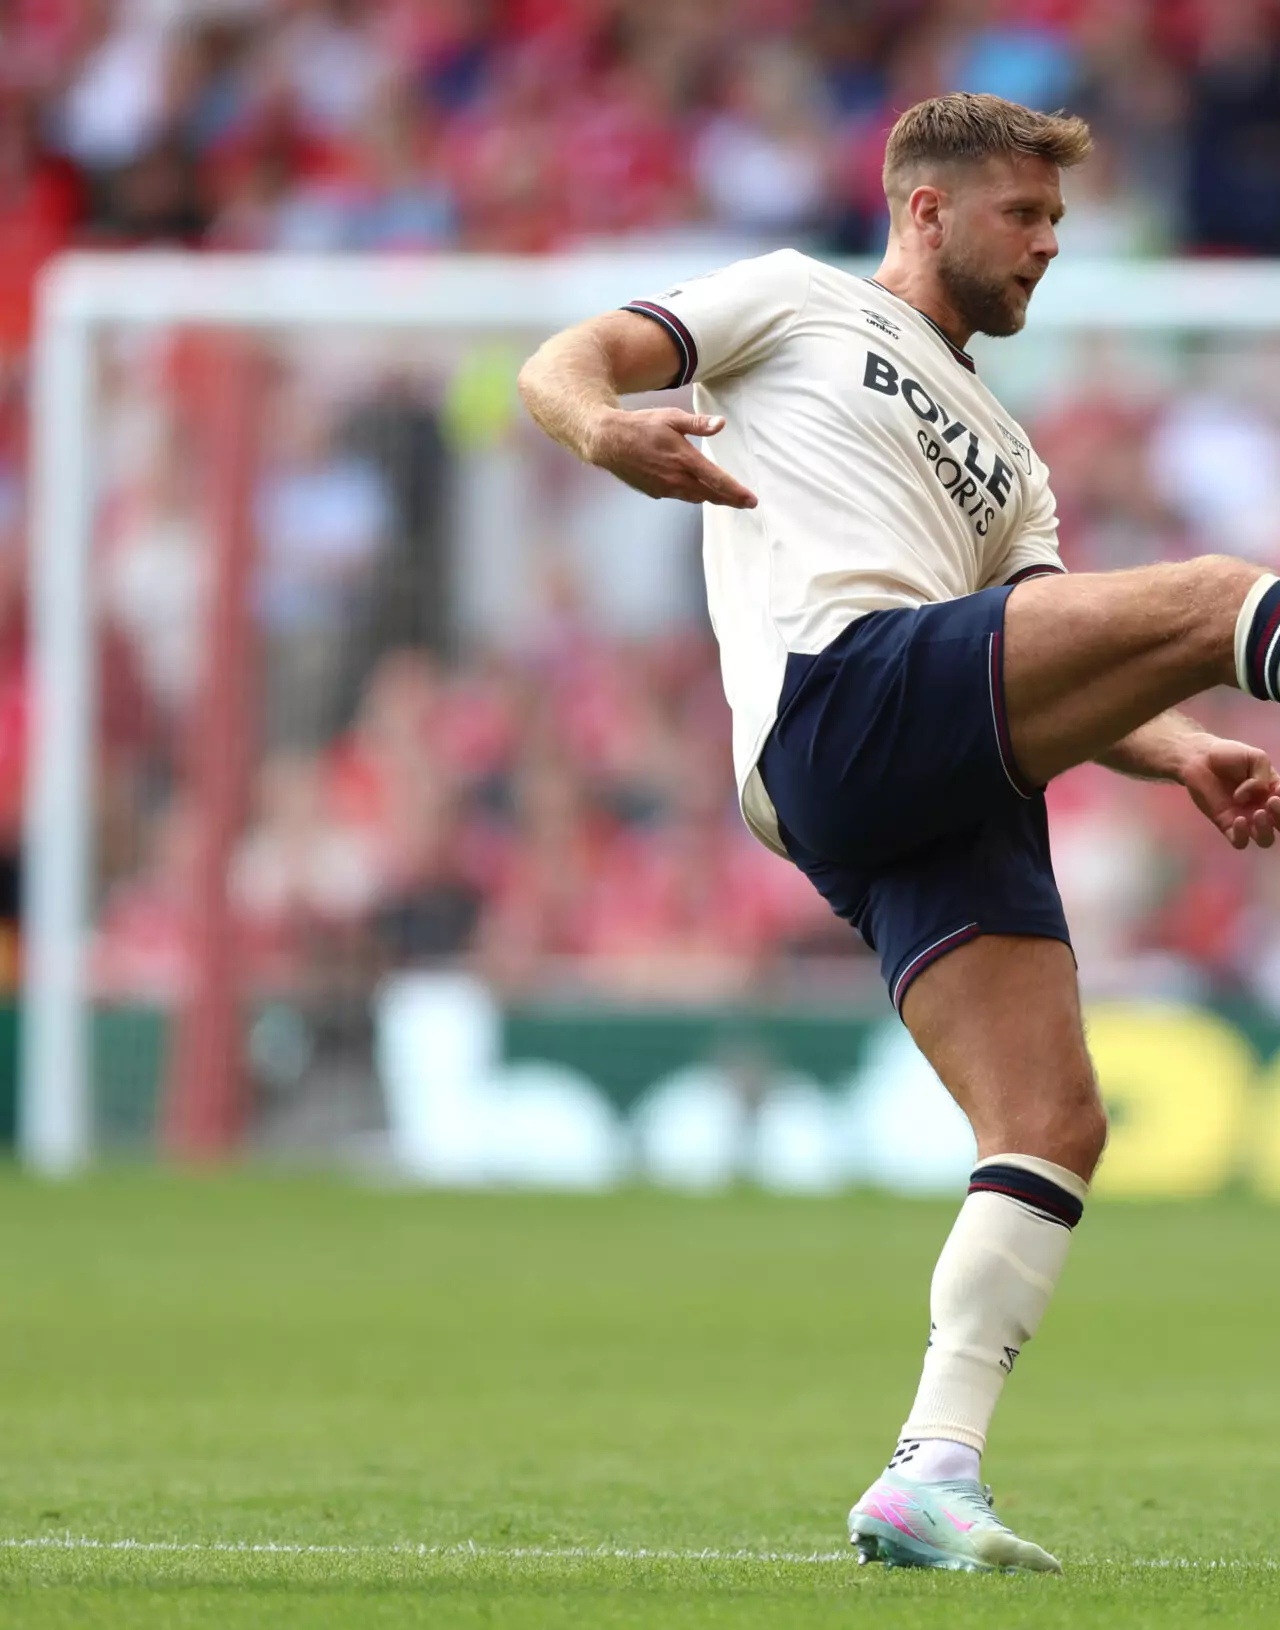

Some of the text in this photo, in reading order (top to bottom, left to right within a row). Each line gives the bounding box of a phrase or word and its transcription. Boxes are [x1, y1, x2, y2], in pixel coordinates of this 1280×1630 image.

[866, 318, 899, 340] umbro
[863, 351, 1013, 508] BOYLE
[917, 430, 994, 536] SPORTS
